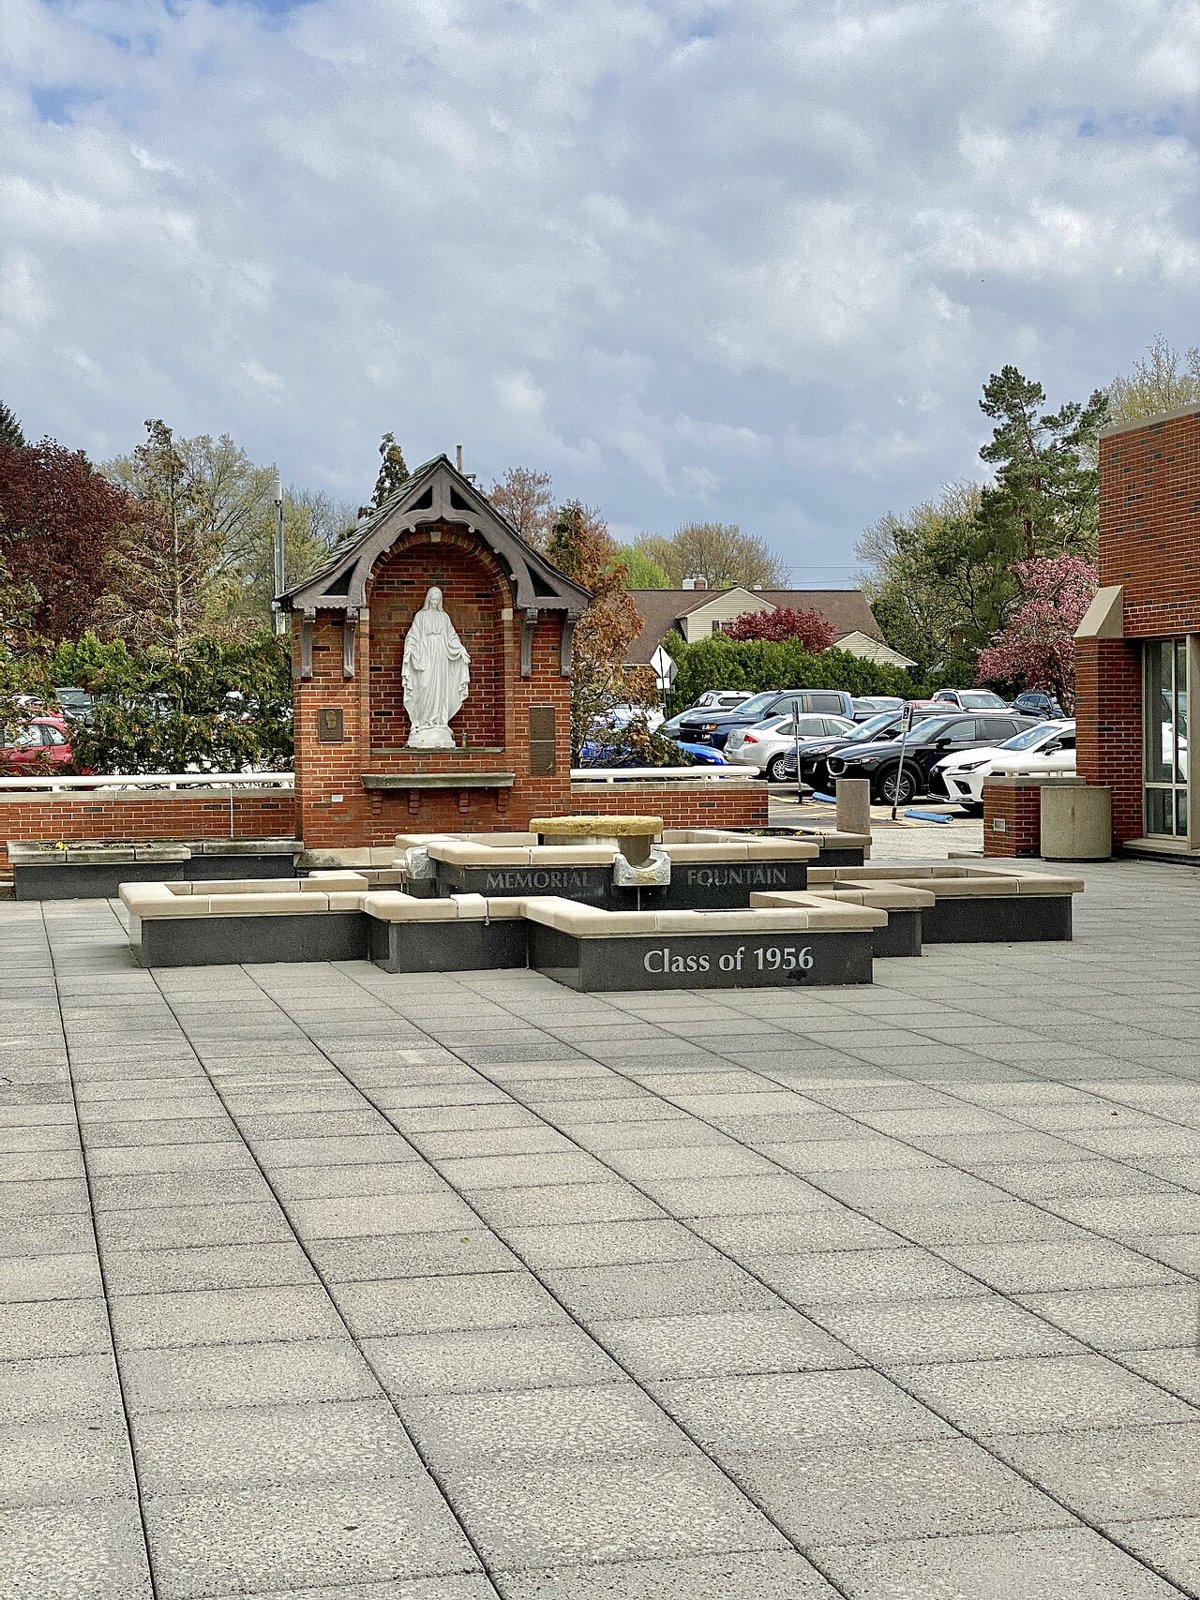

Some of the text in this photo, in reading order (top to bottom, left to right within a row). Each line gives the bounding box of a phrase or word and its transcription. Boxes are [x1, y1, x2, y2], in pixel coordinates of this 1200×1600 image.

[486, 867, 787, 889] MEMORIAL FOUNTAIN
[643, 946, 814, 973] Class of 1956
